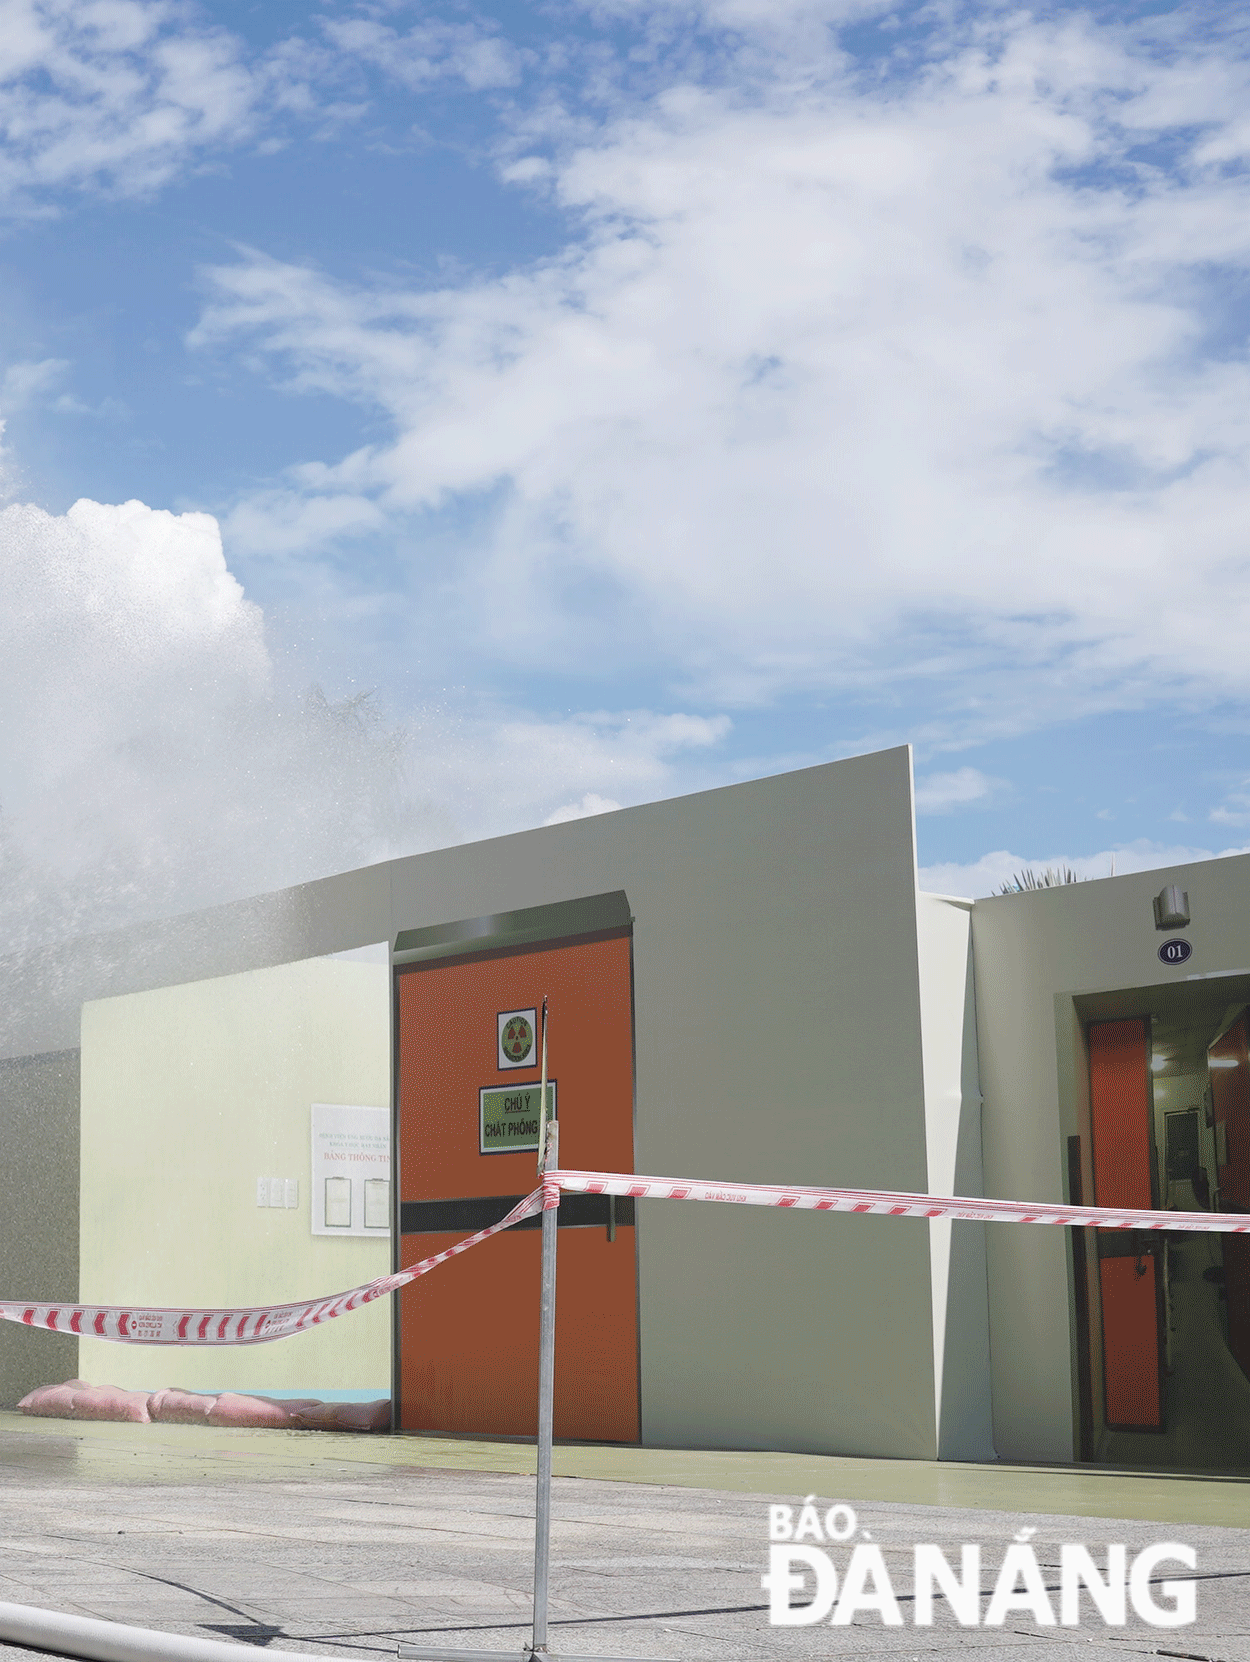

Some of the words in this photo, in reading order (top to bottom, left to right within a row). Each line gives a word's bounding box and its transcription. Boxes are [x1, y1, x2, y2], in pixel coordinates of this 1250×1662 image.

[1167, 945, 1183, 959] 01
[504, 1093, 522, 1111] CHÚ
[525, 1092, 531, 1110] Ý
[508, 1118, 538, 1136] PHÓNG
[348, 1152, 377, 1162] THÔNG
